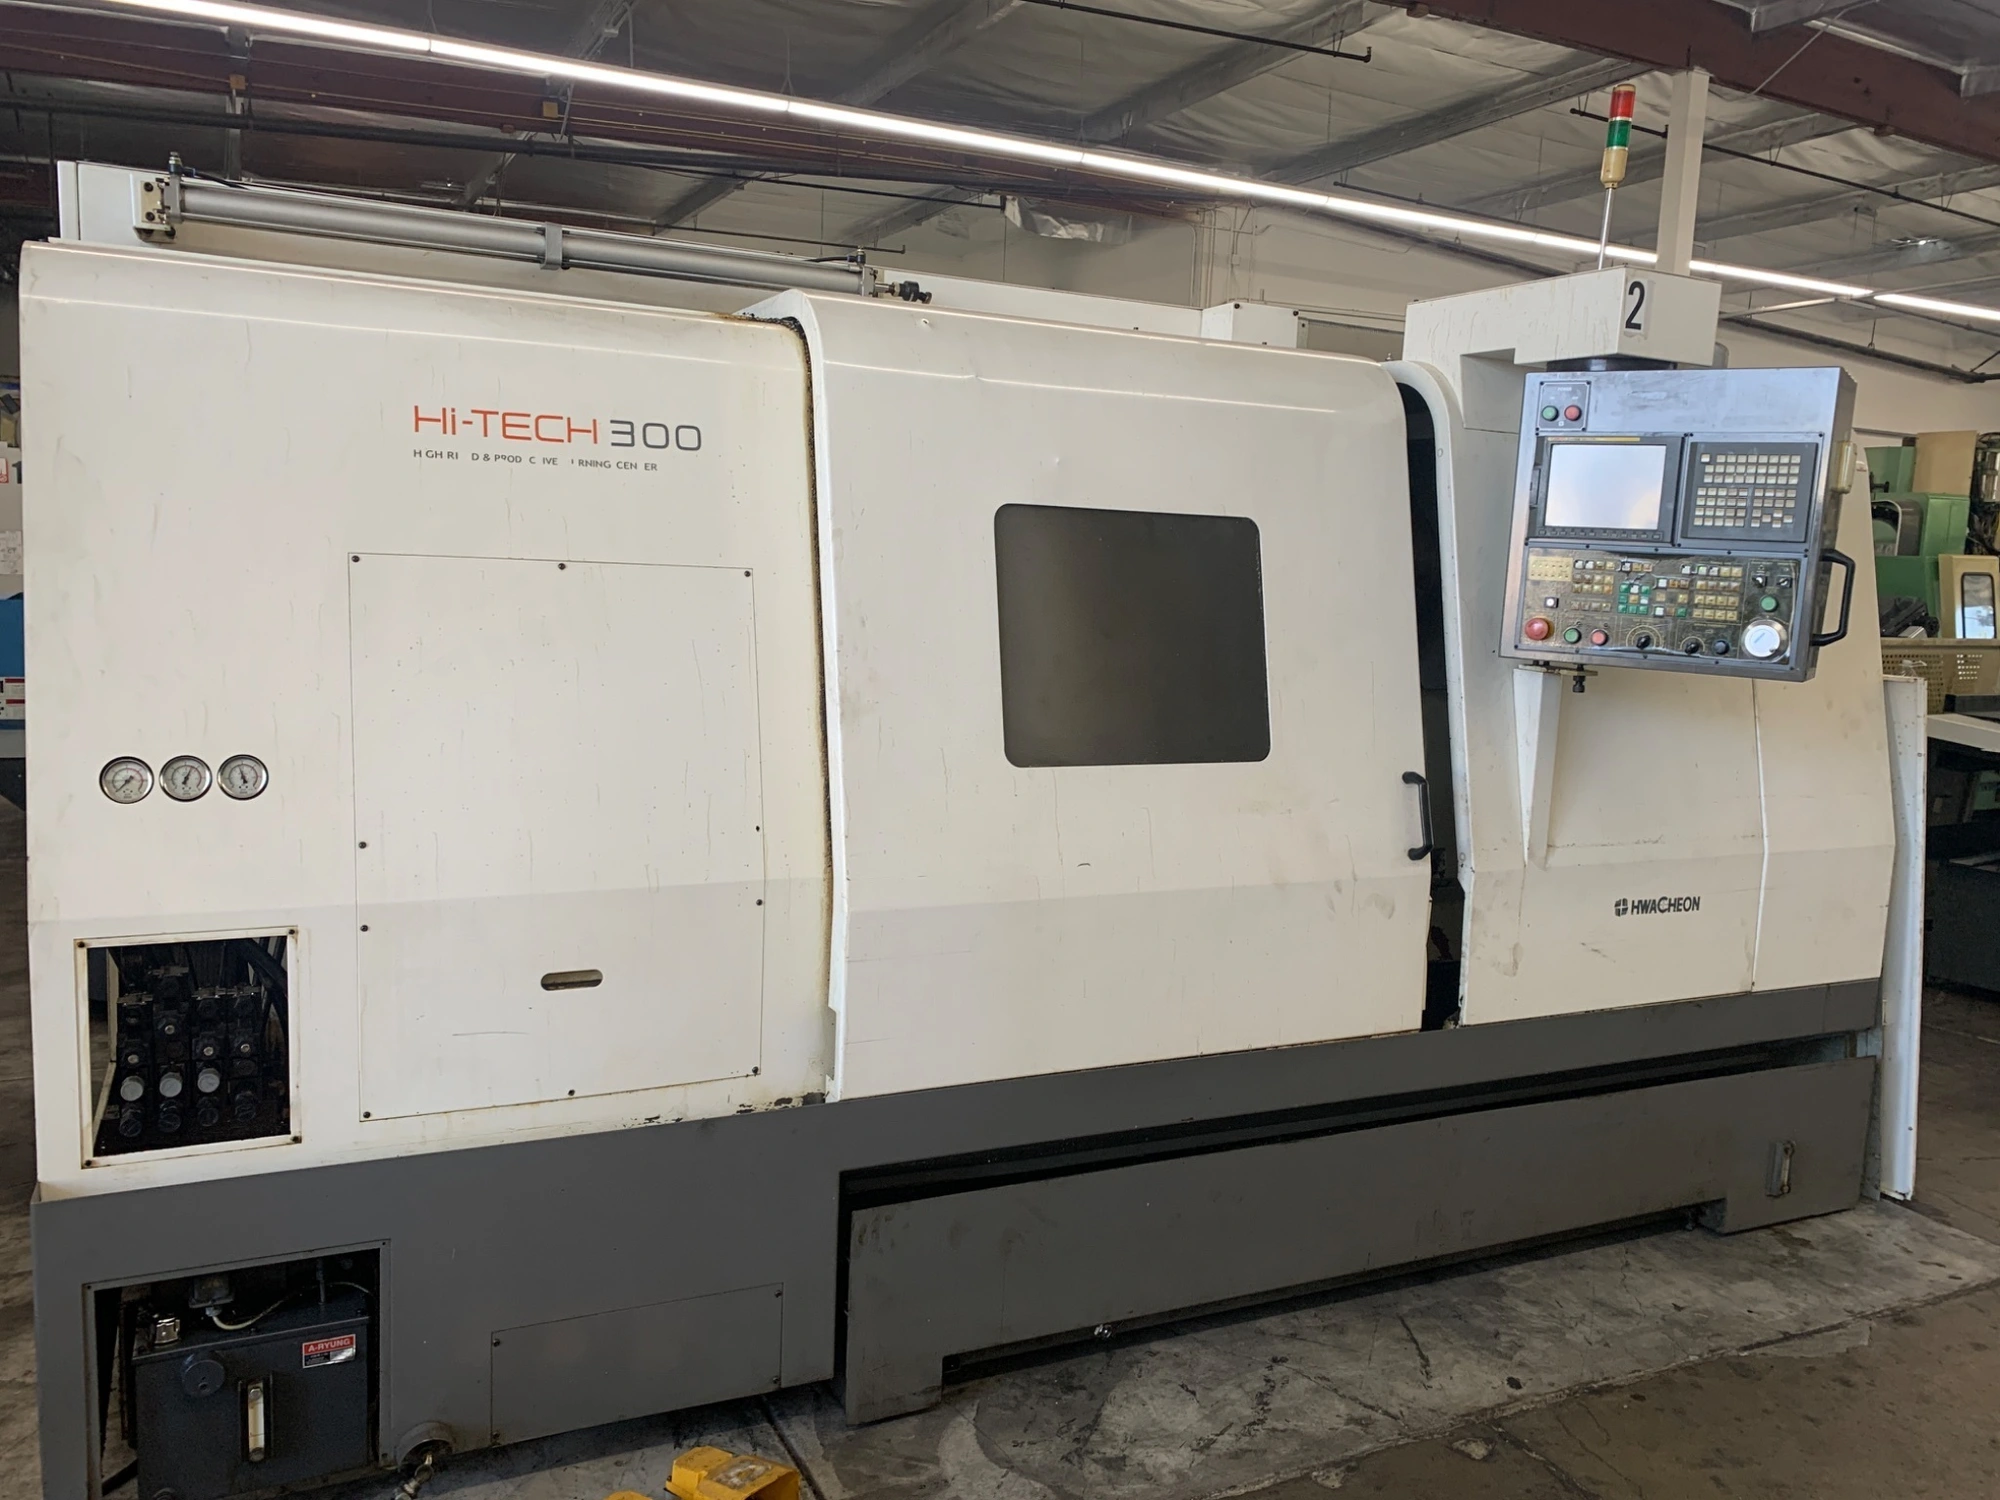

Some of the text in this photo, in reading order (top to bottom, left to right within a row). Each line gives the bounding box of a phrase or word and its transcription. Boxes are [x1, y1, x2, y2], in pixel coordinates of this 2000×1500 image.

[1625, 280, 1645, 330] 2
[414, 405, 702, 451] Hi-TECH 300
[413, 449, 658, 471] HGH RID & PRODCIVE RNING CENER
[1631, 896, 1701, 915] HWACHEON
[308, 1338, 351, 1352] A-RYUNG
